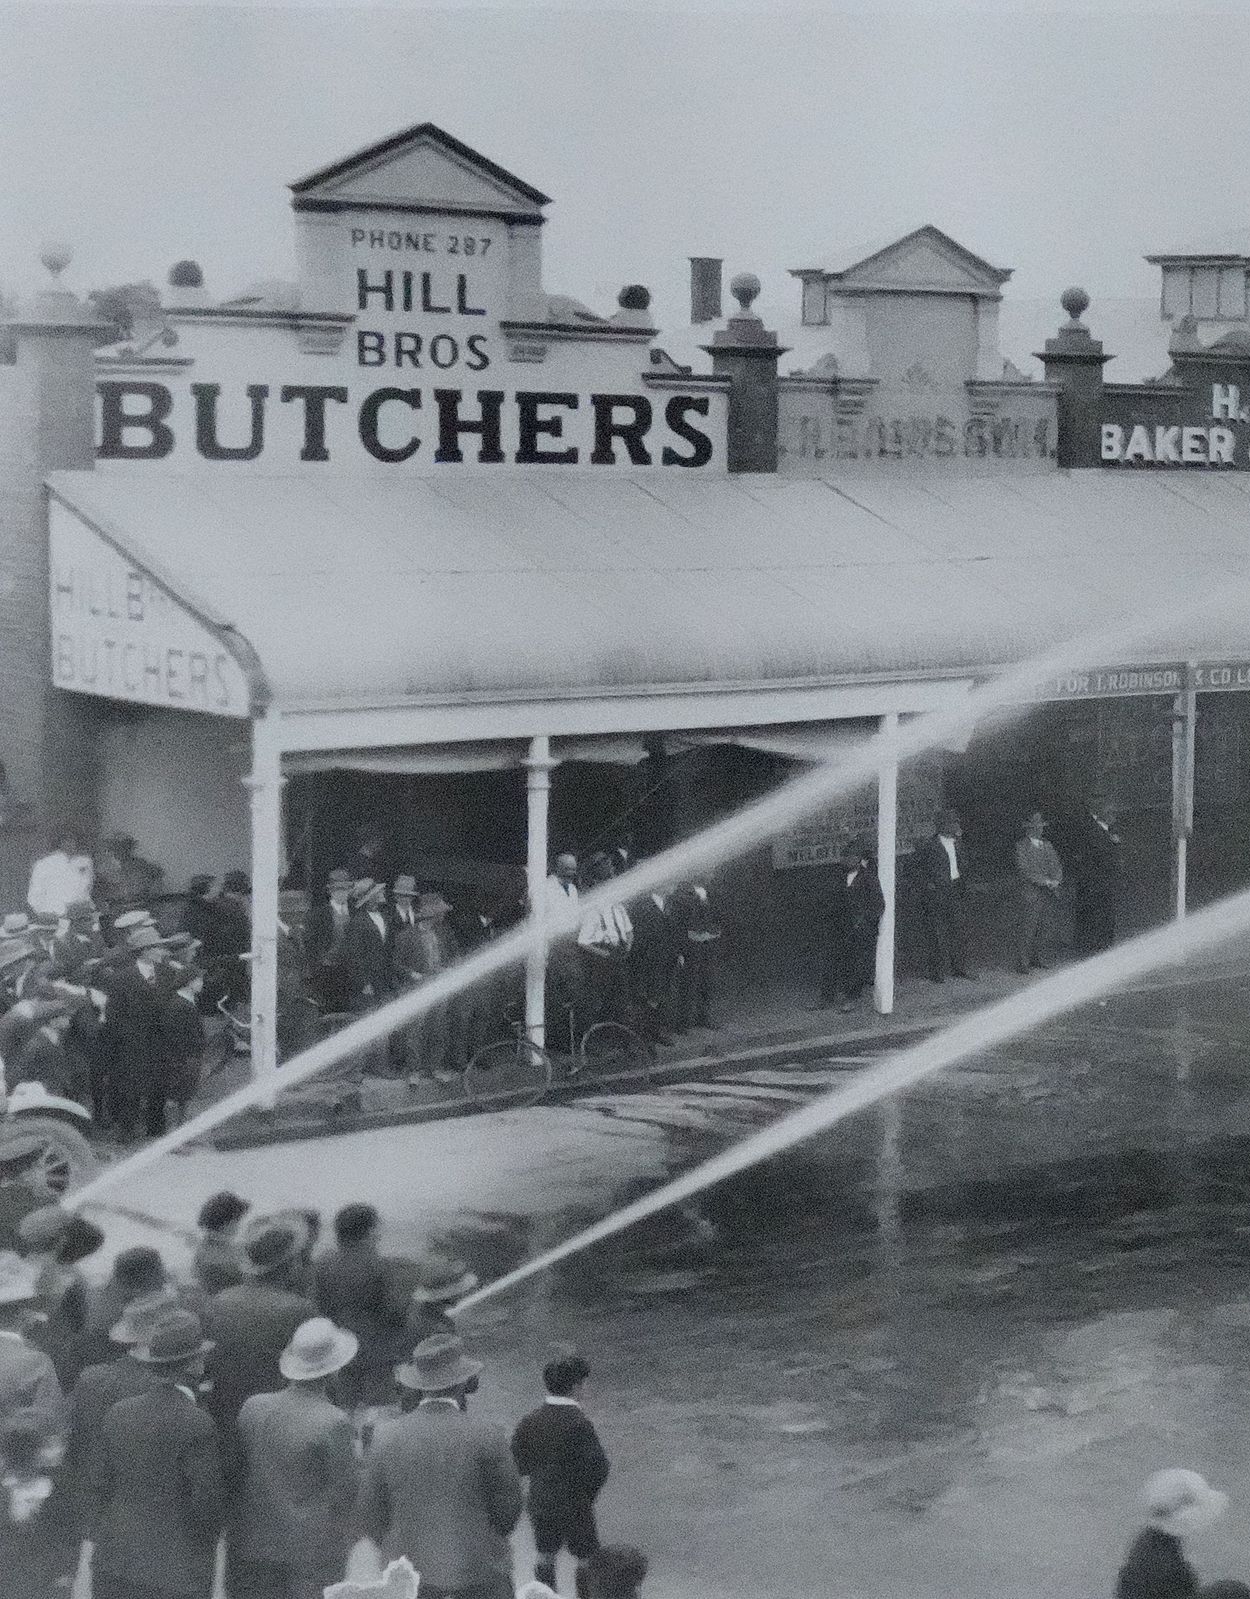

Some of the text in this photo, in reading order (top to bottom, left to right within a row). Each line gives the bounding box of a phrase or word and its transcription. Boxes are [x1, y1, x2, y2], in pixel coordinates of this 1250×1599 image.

[351, 228, 492, 256] PHONE 287
[356, 268, 487, 316] HILL
[357, 330, 491, 371] BROS
[95, 381, 714, 469] BUTCHERS
[1100, 423, 1236, 465] BAKER
